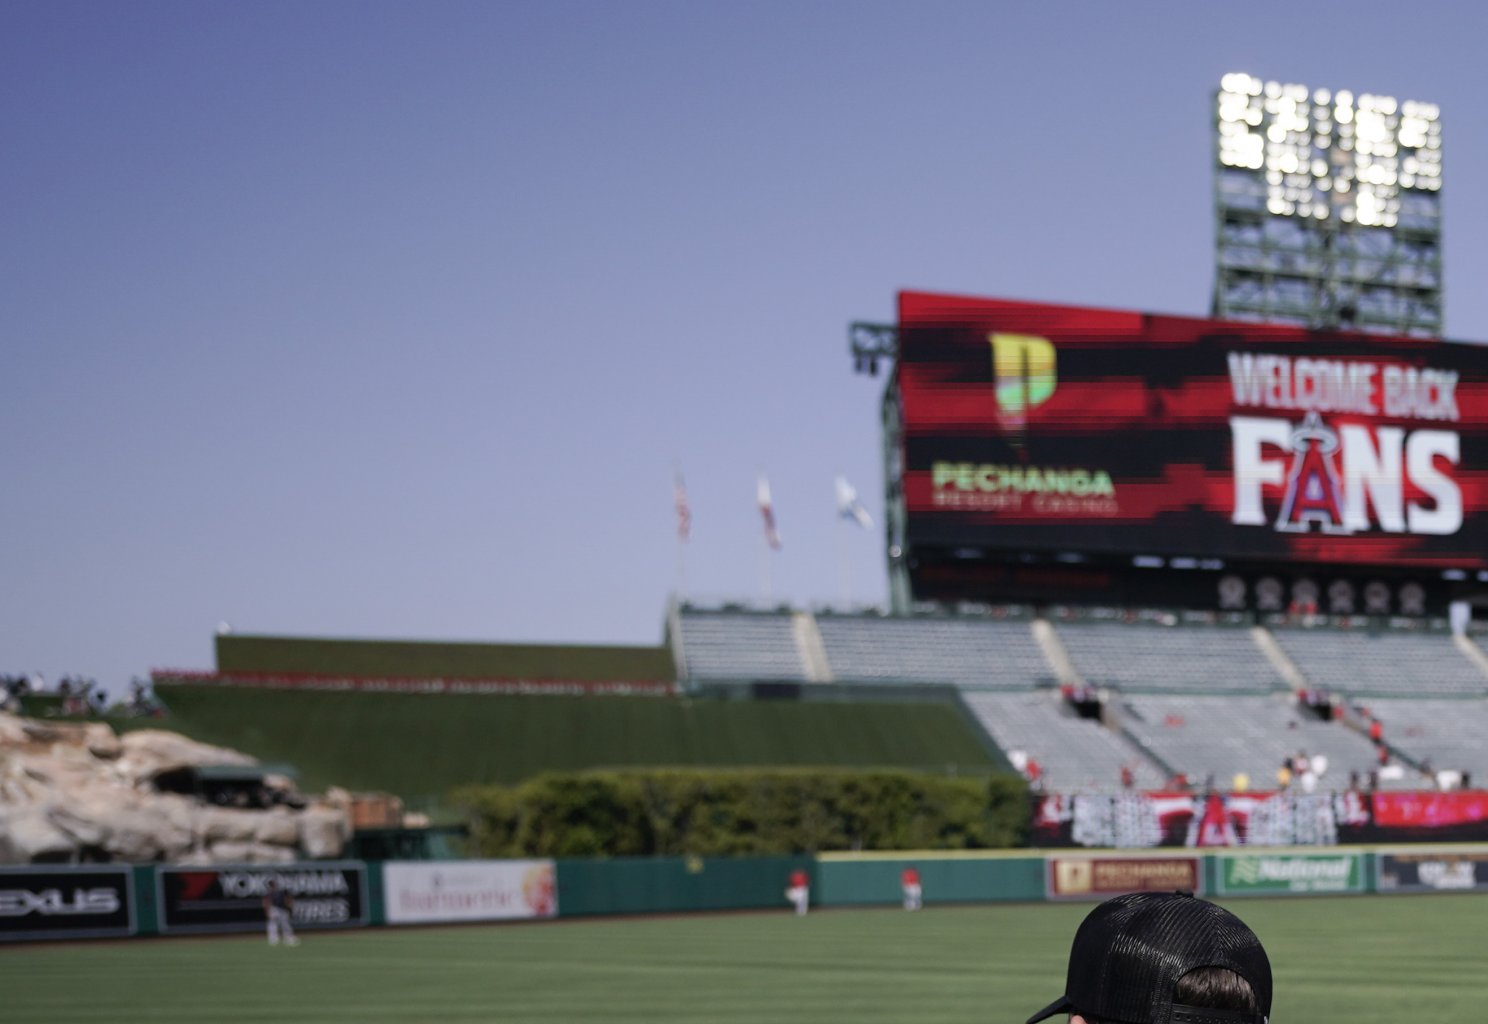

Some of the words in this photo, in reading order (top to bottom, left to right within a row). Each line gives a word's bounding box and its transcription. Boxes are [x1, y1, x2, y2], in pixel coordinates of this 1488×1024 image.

[1227, 351, 1378, 415] WELCOME
[1381, 364, 1460, 421] BACK
[932, 461, 1115, 498] PECHANGA
[1230, 410, 1462, 534] FANS
